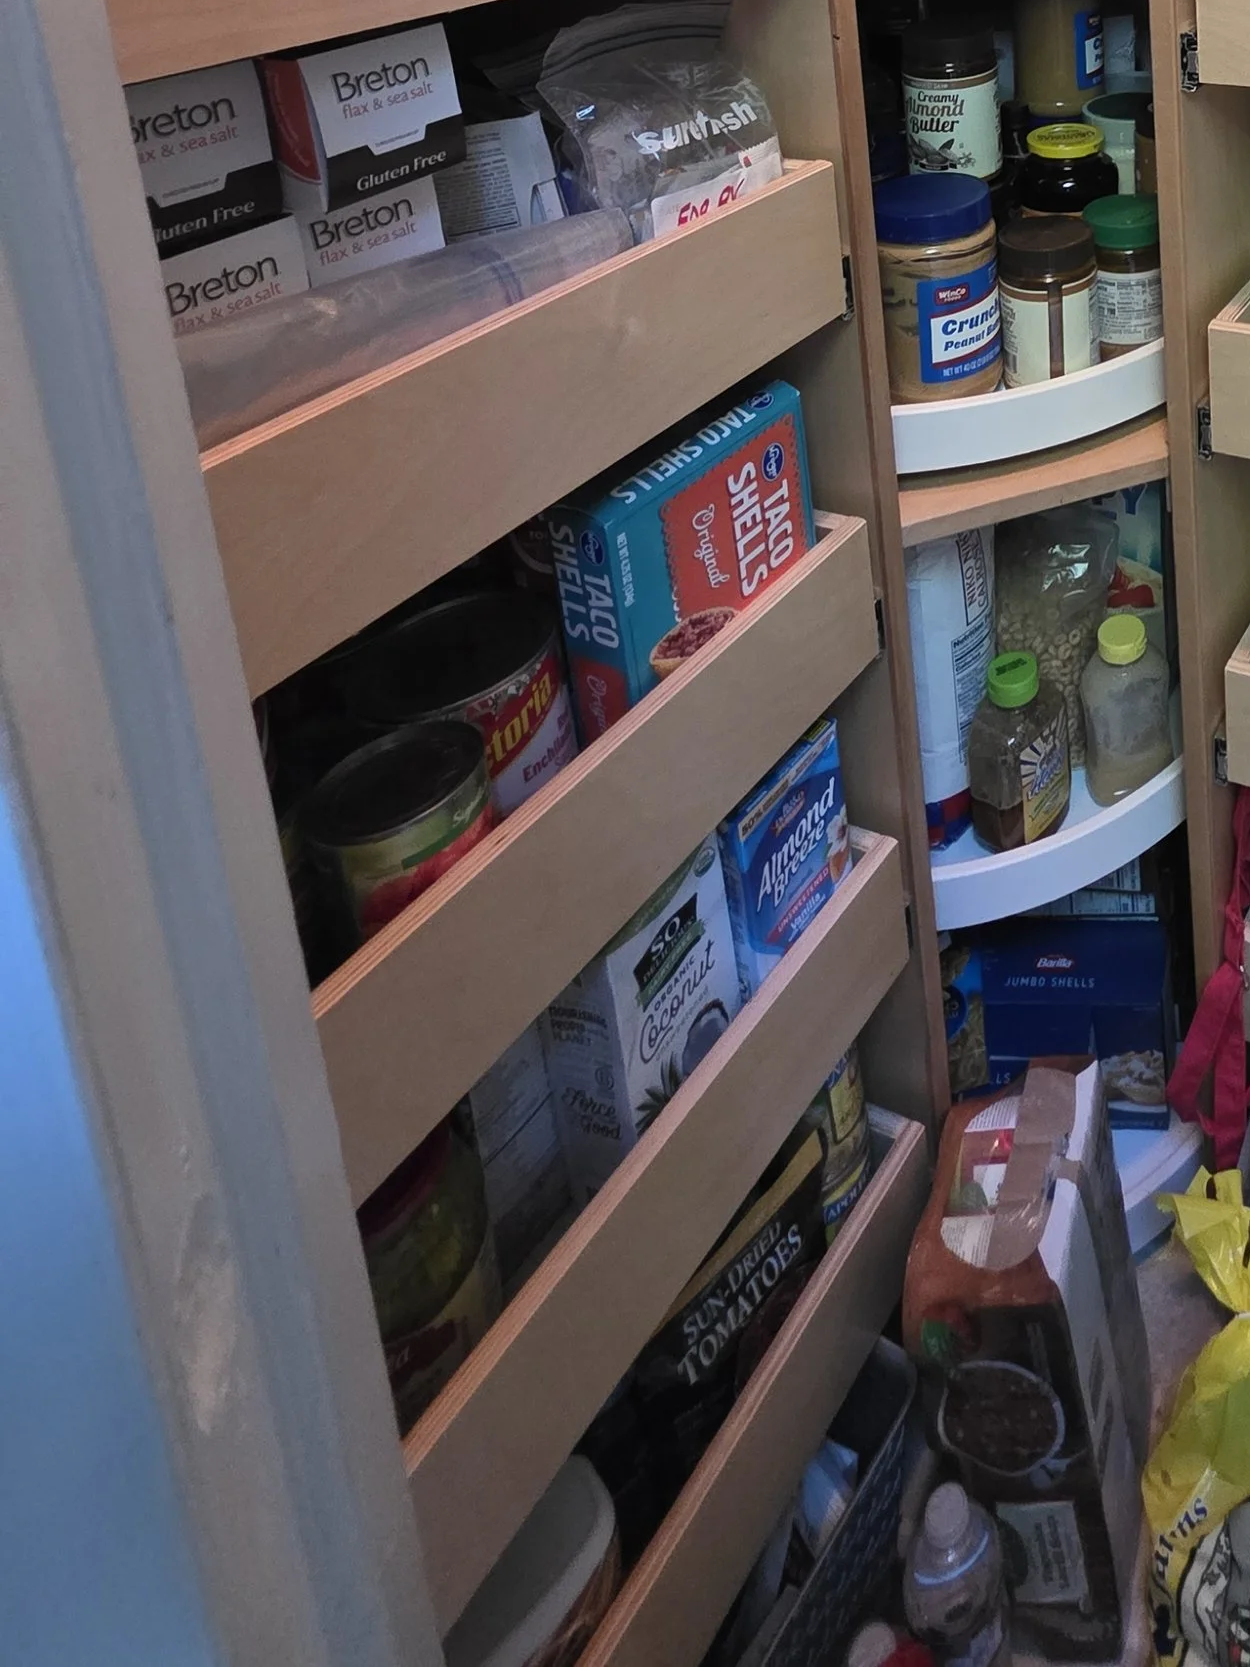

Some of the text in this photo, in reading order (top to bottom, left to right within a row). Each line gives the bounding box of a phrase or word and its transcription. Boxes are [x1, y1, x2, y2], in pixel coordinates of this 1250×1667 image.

[331, 56, 432, 104] Breton
[342, 82, 434, 119] flax & sea salt
[907, 96, 965, 117] Almond
[918, 90, 959, 105] Creamy
[160, 124, 239, 159] & sea salt
[910, 116, 960, 134] Butter
[356, 149, 448, 192] Gluten Free
[211, 199, 257, 224] Free
[309, 197, 415, 251] Breton
[319, 219, 418, 266] flax & sea salt
[165, 255, 282, 318] Breton
[174, 281, 283, 335] flax & sea salt
[939, 288, 966, 300] WinCo
[943, 332, 985, 352] Peanut
[609, 406, 758, 505] TACO SHELLS
[692, 502, 731, 589] Original
[727, 460, 769, 598] SHELLS
[763, 478, 794, 570] TACO
[549, 521, 591, 643] SHELLS
[966, 565, 978, 608] NIKO
[583, 573, 620, 650] TACO
[756, 776, 836, 914] Almond
[773, 816, 826, 910] Breeze
[777, 865, 831, 934] UNSWEETENED
[649, 915, 682, 960] SO
[1036, 957, 1075, 969] Barilla
[639, 937, 717, 1065] Coconut
[653, 956, 697, 1012] ORGANIC
[1004, 975, 1097, 989] JUMBO SHELLS
[677, 1222, 804, 1387] TOMATOES
[682, 1220, 783, 1347] SUN-DRIED
